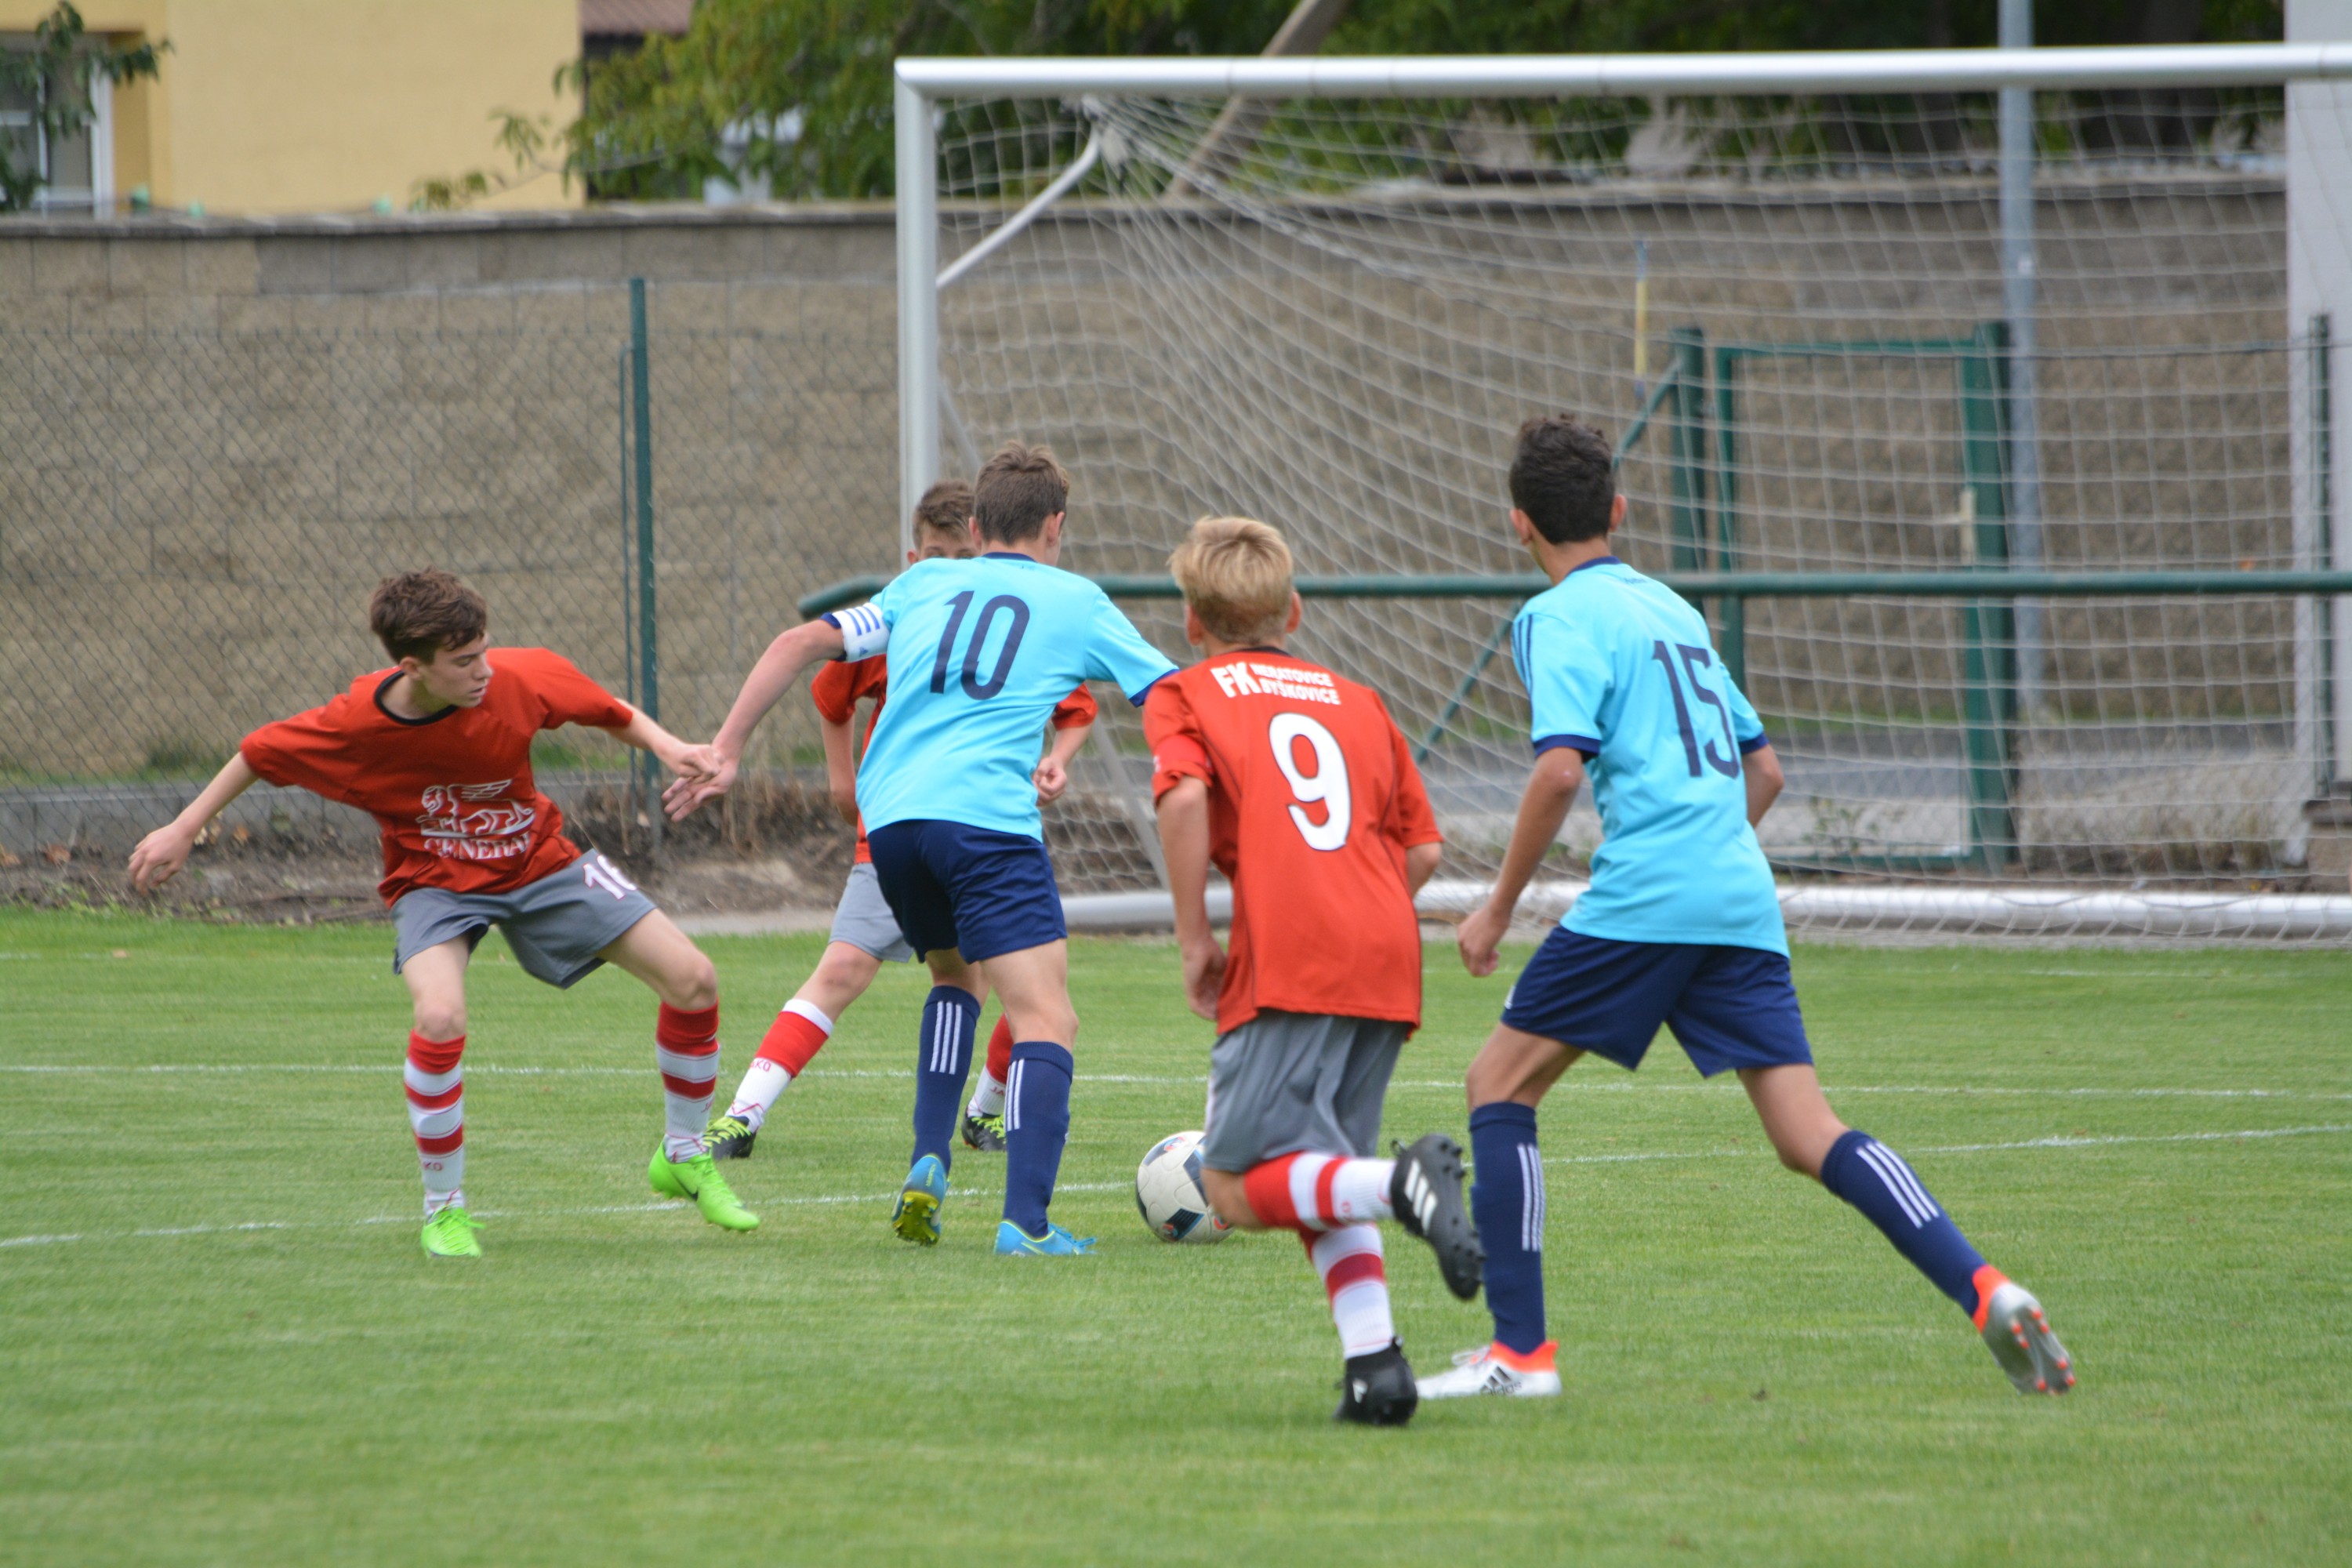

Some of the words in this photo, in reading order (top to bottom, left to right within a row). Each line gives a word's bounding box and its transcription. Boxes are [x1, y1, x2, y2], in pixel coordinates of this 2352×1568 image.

[930, 590, 1031, 701] 10
[1210, 662, 1263, 698] FK
[1652, 640, 1740, 780] 15
[1268, 712, 1352, 851] 9
